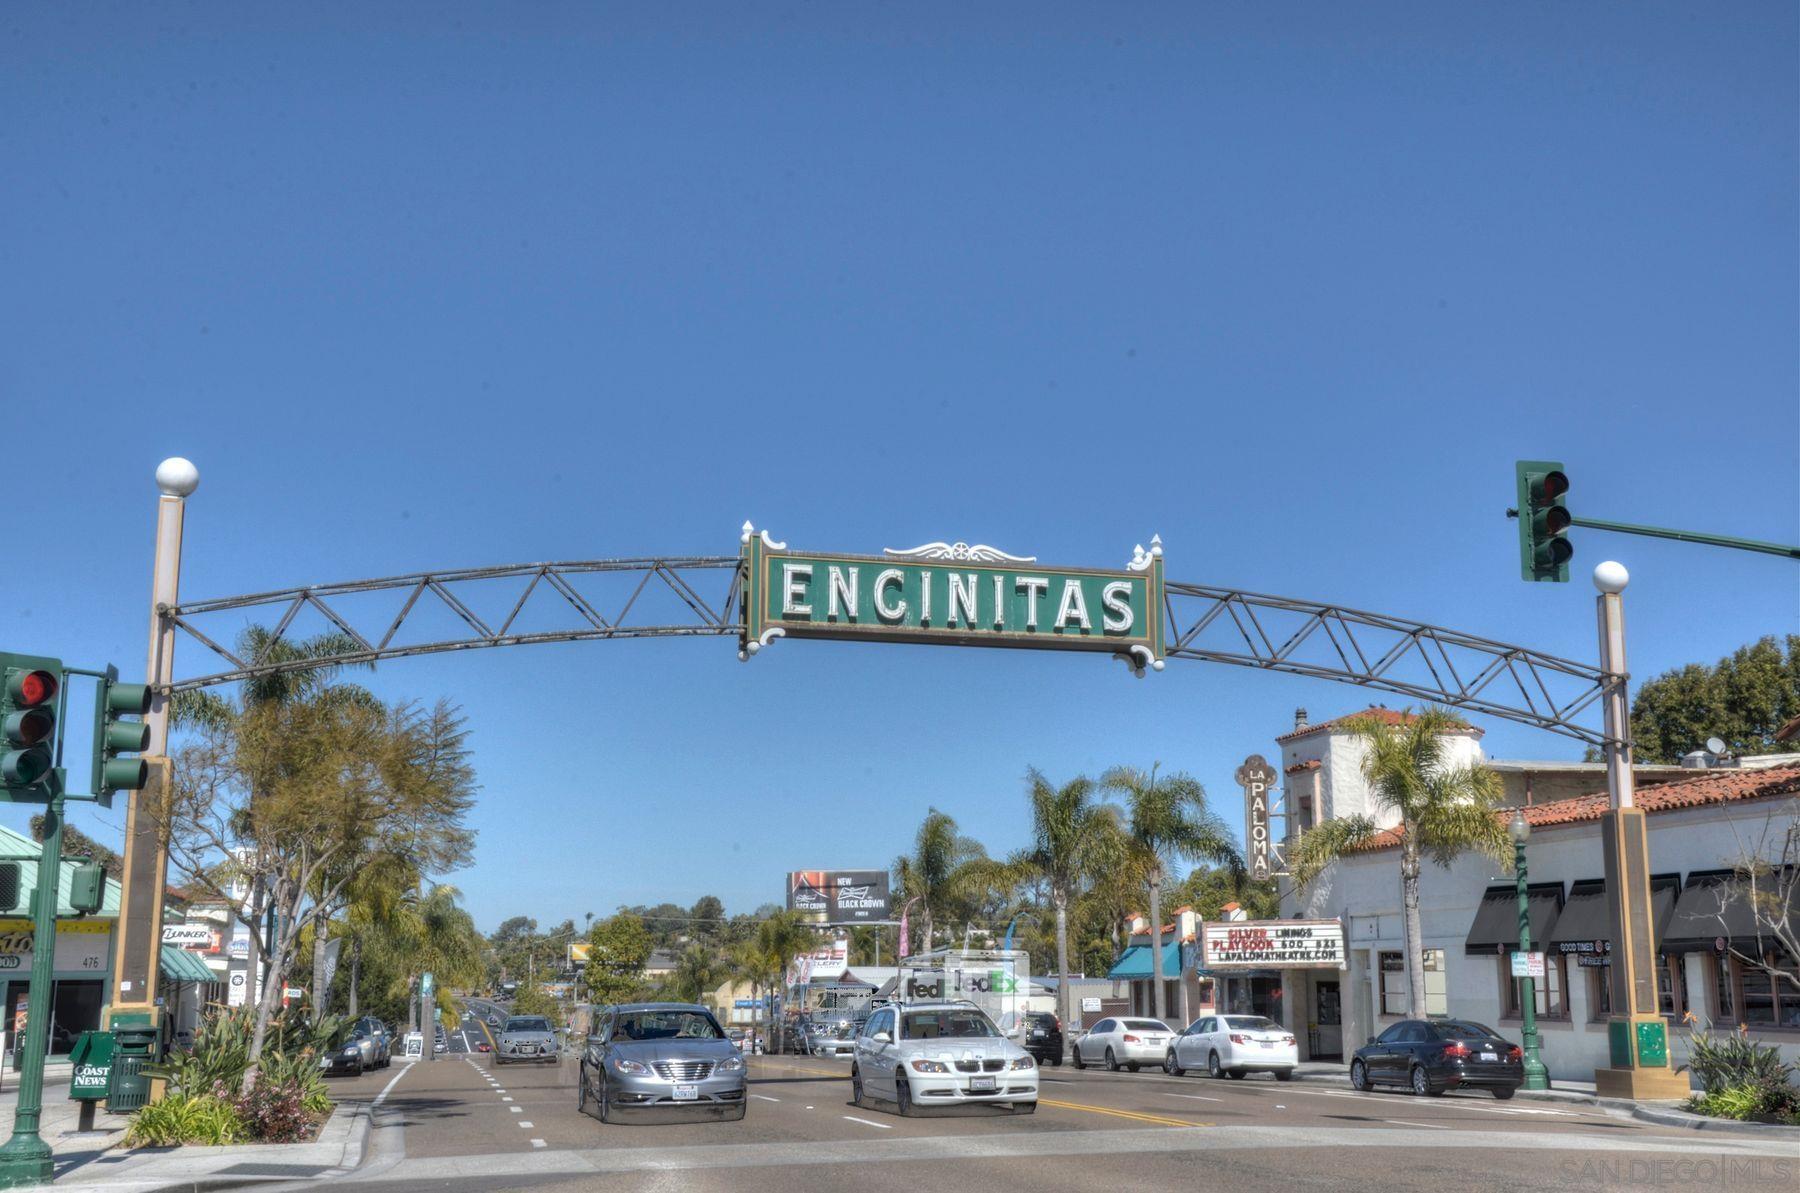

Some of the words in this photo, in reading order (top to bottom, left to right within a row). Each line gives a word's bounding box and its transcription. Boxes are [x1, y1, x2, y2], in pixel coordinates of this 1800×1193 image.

[782, 563, 1134, 632] ENCINITAS
[1249, 770, 1265, 779] LA
[1251, 782, 1268, 870] PALOMA
[837, 877, 852, 886] NEW
[838, 900, 859, 908] BLACK
[860, 899, 885, 908] CROWN
[1228, 929, 1267, 939] SILVER
[1276, 928, 1312, 938] LININGS
[1212, 940, 1274, 951] PLAYBOOK
[83, 957, 99, 968] 476
[74, 1065, 110, 1076] COAST
[74, 1075, 107, 1086] NEWS
